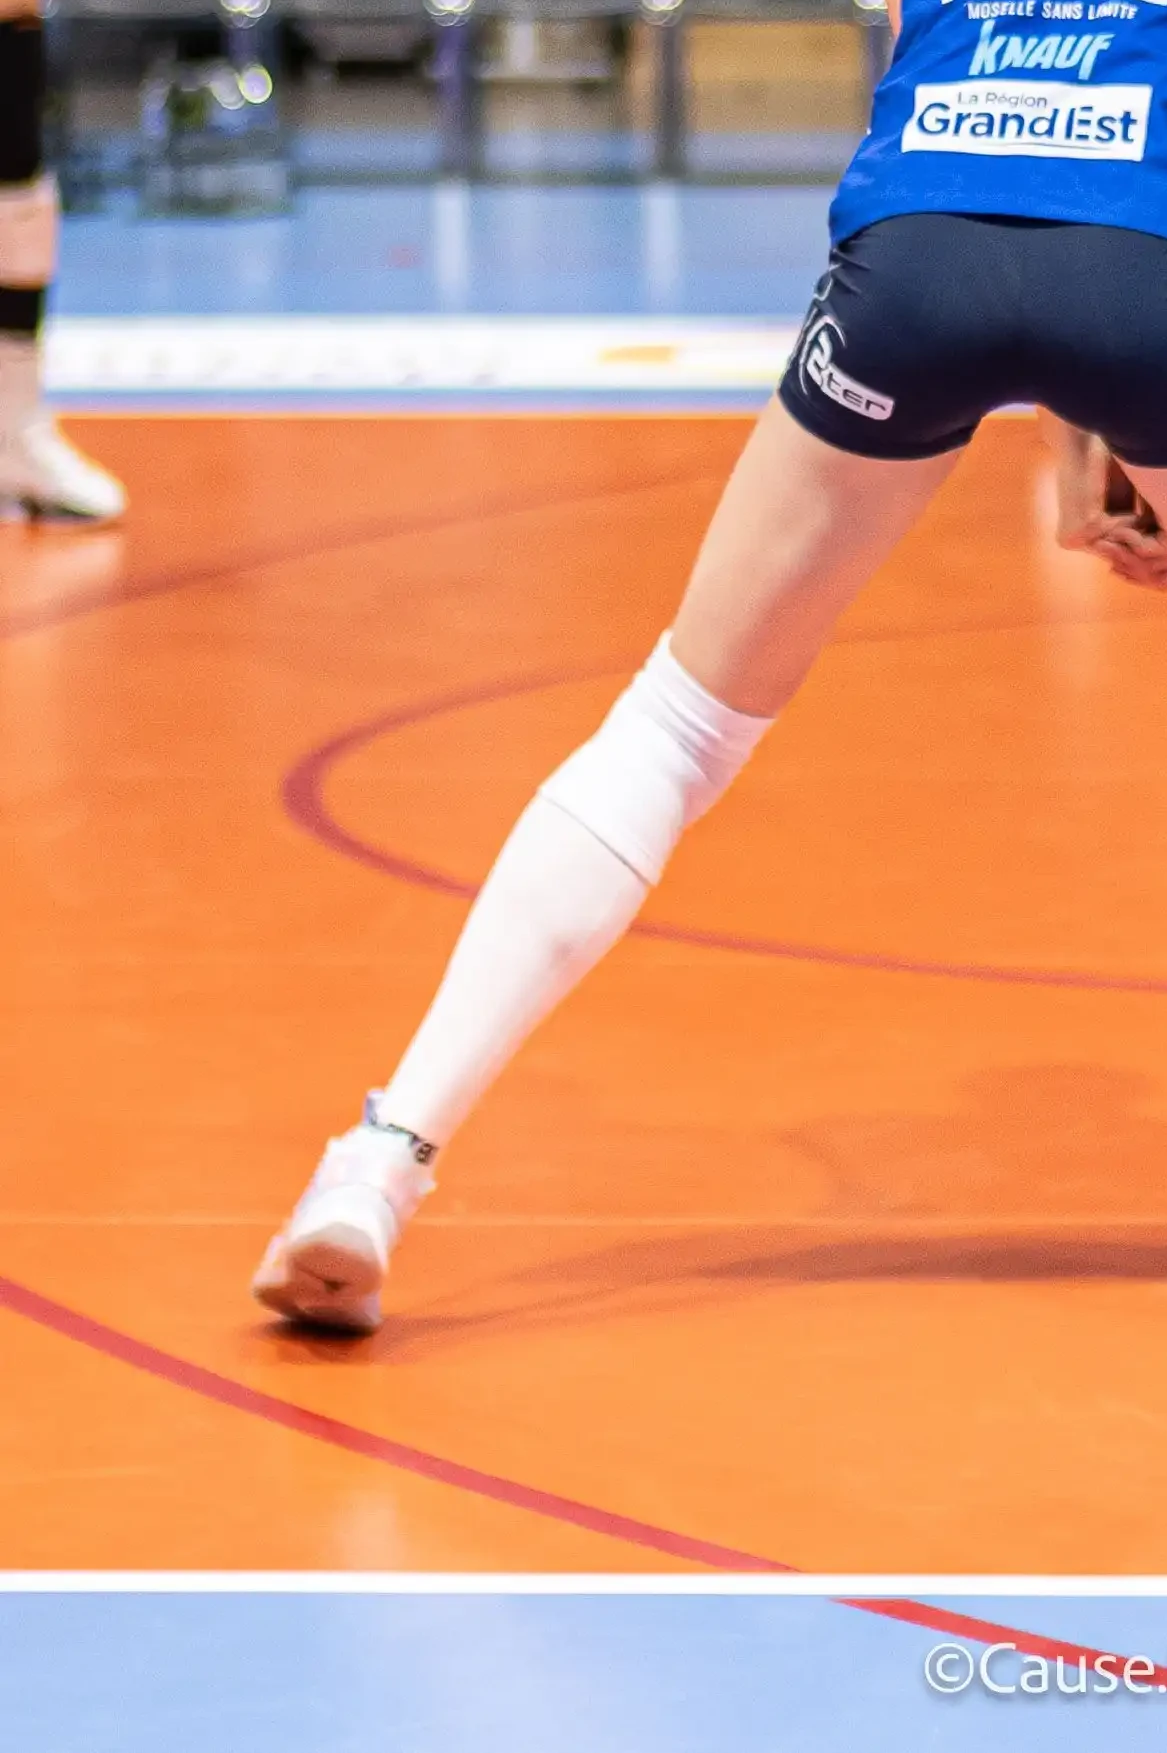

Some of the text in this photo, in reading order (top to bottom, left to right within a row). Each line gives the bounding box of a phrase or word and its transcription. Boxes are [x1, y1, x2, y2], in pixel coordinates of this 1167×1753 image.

[966, 0, 1035, 20] MOSELLE
[1041, 1, 1083, 20] SANS
[968, 19, 1115, 80] KNAUF
[957, 92, 1048, 109] La Région
